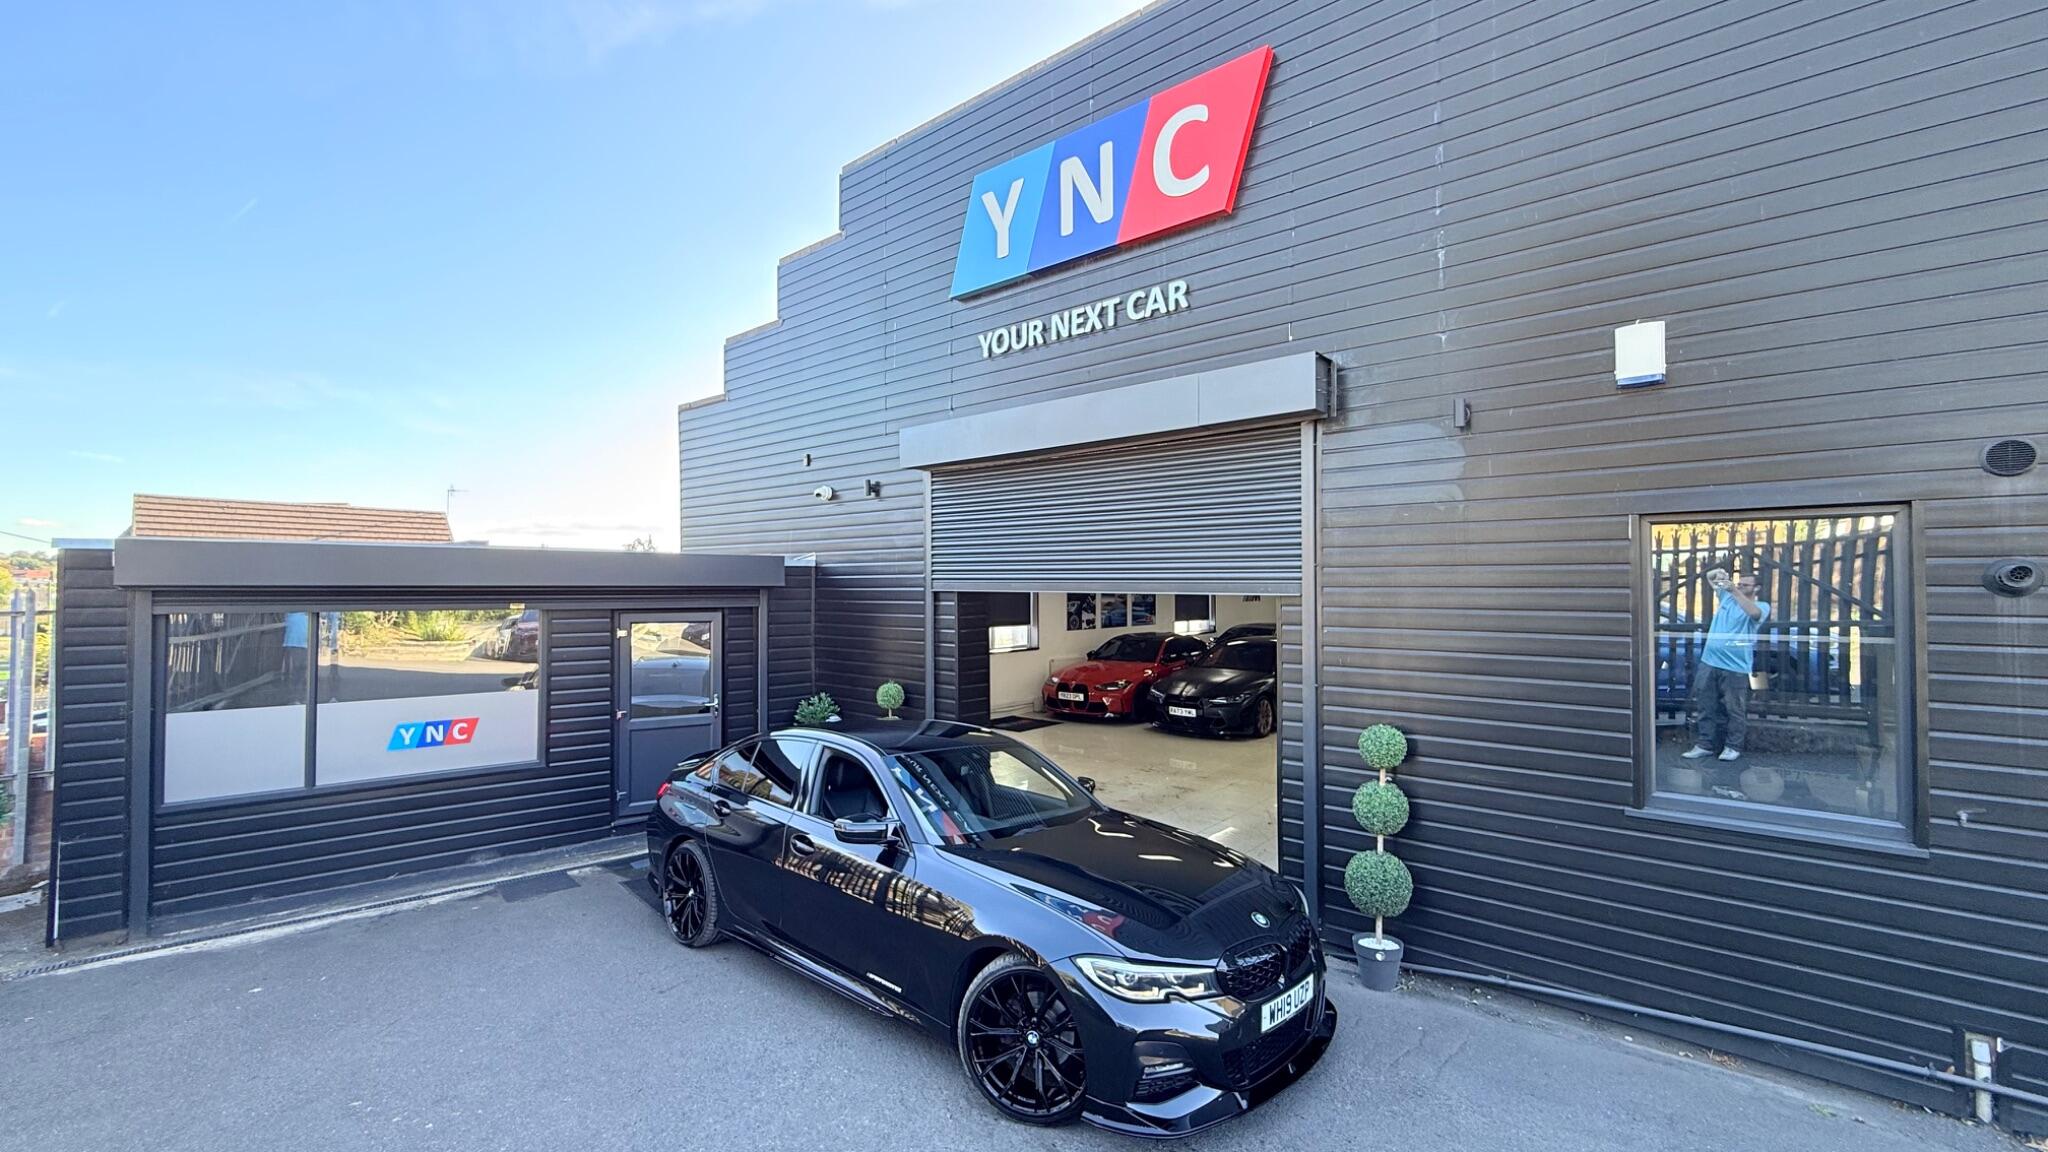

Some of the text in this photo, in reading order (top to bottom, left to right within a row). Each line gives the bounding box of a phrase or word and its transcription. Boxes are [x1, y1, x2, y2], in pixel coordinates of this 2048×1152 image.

[981, 104, 1210, 259] YNC
[977, 280, 1190, 358] YOUR NEXT CAR
[400, 722, 468, 745] YNC
[1269, 980, 1310, 1026] WH19 UZP
